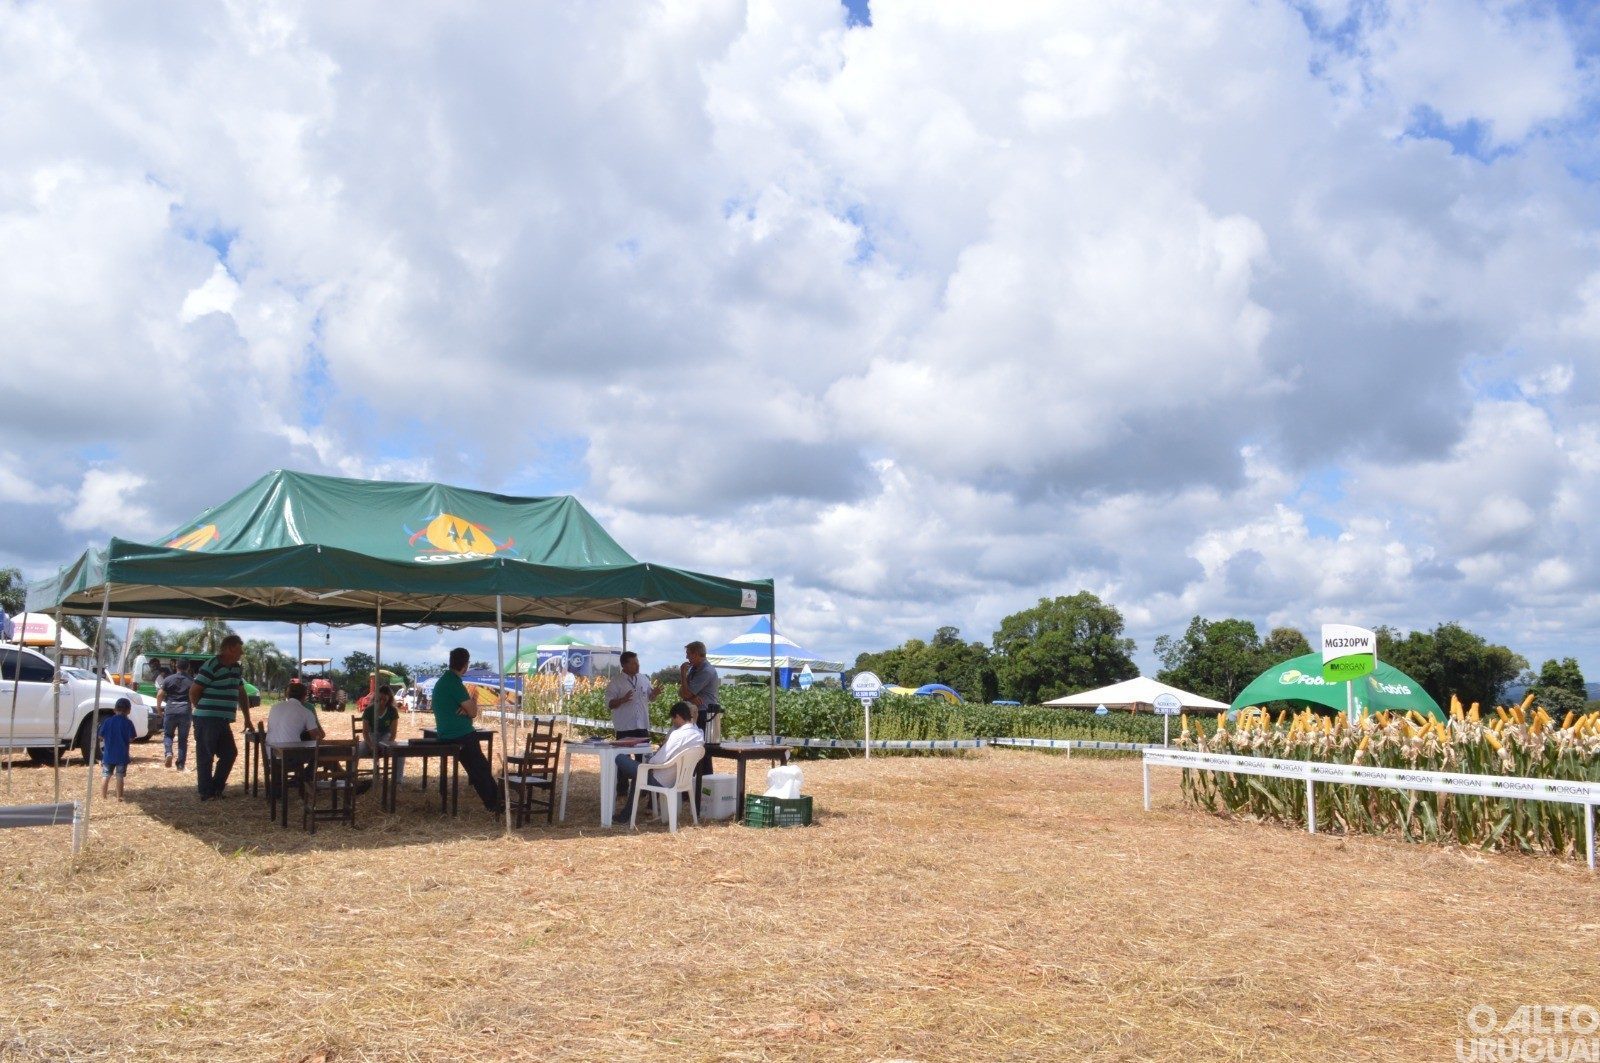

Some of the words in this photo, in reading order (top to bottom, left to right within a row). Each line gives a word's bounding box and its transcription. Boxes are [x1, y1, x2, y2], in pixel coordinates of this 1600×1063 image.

[1325, 638, 1369, 648] MG320PW
[1331, 663, 1366, 671] MORGAN
[1378, 682, 1412, 695] Fabris
[1172, 754, 1197, 762] MORGAN
[1203, 757, 1230, 765] MORGAN
[1238, 760, 1266, 769] MORGAN
[1274, 763, 1303, 772] MORGAN
[1313, 767, 1344, 776] MORGAN
[1354, 770, 1387, 780] MORGAN
[1398, 774, 1433, 783] MORGAN
[1445, 777, 1482, 787] MORGAN
[1495, 781, 1534, 791] MORGAN
[1548, 784, 1590, 795] MORGAN
